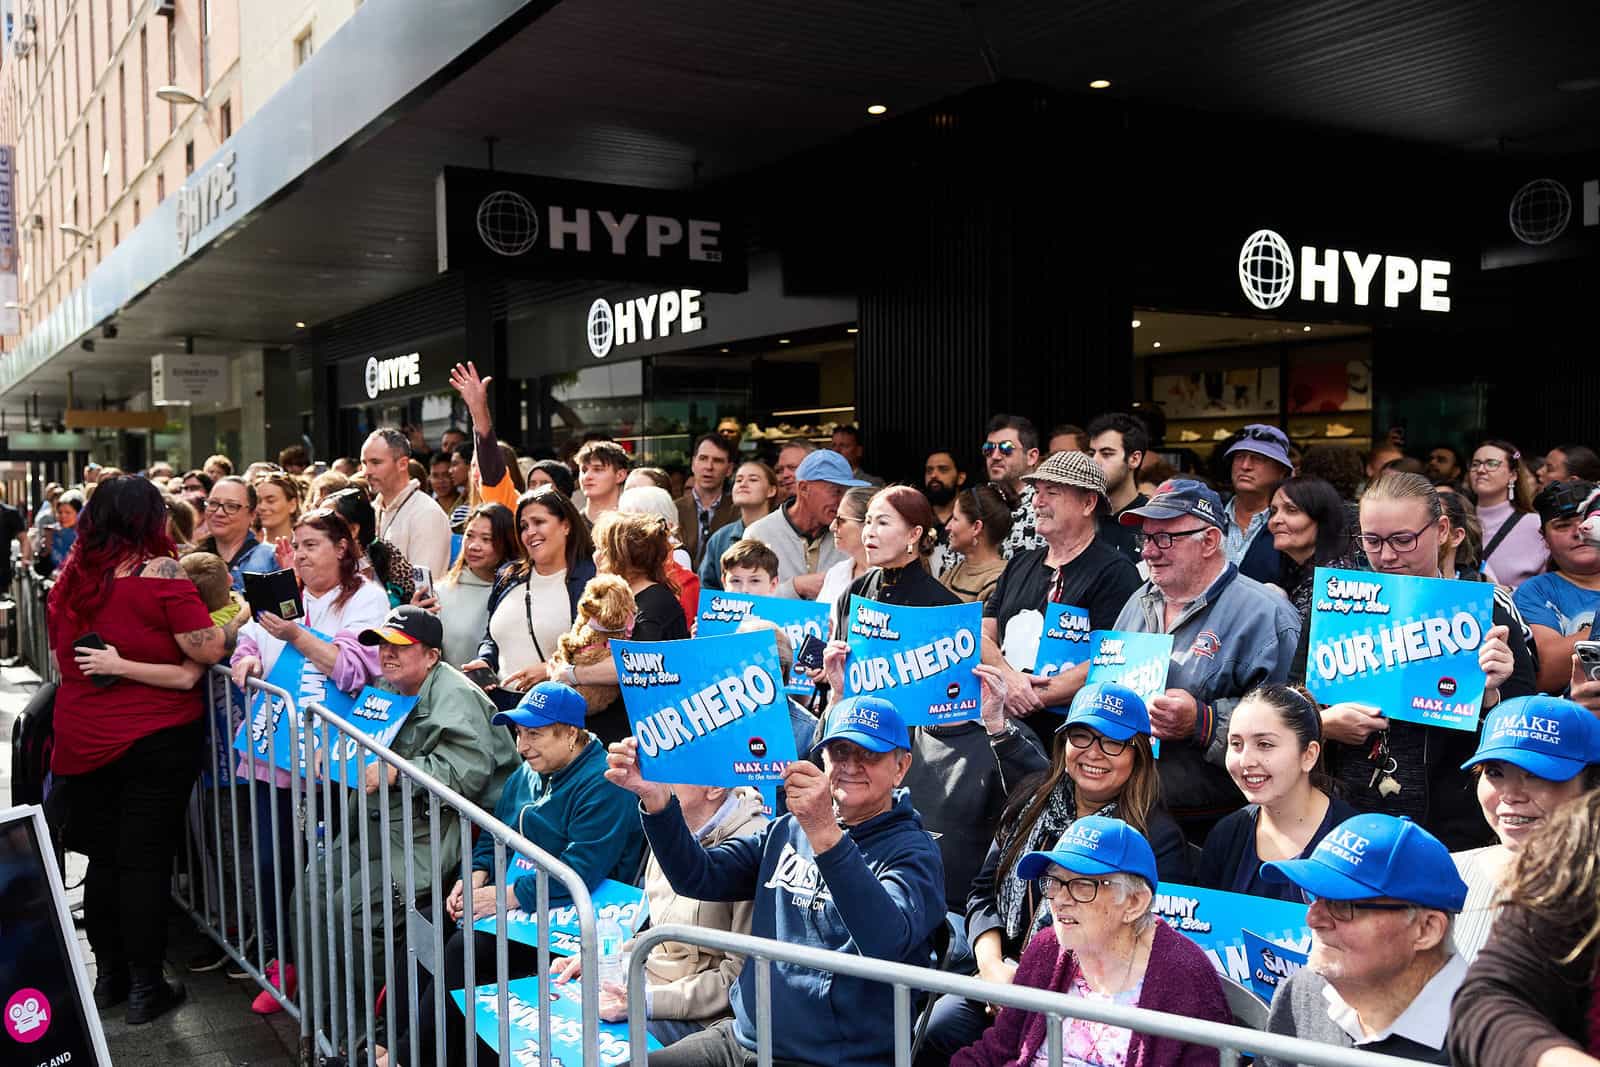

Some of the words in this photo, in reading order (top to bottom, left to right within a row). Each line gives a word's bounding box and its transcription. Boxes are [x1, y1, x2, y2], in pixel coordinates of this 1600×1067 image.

[187, 147, 236, 236] HYPE
[548, 206, 721, 262] HYPE
[1300, 246, 1450, 312] HYPE
[615, 289, 701, 345] HYPE
[379, 353, 420, 391] HYPE
[1328, 577, 1381, 601] SAMMY
[622, 649, 663, 671] SAMMY
[850, 658, 896, 693] OUR
[893, 629, 975, 684] HERO
[1317, 634, 1380, 680] OUR
[1380, 612, 1481, 666] HERO
[636, 706, 694, 757] OUR
[681, 664, 776, 736] HERO
[929, 703, 952, 713] MAX
[960, 699, 976, 709] ALI
[1412, 697, 1443, 711] MAX
[1454, 704, 1475, 716] ALI
[1502, 713, 1560, 736] MAKE
[1530, 731, 1560, 745] GREAT
[734, 761, 762, 773] MAX
[50, 1051, 72, 1067] AND
